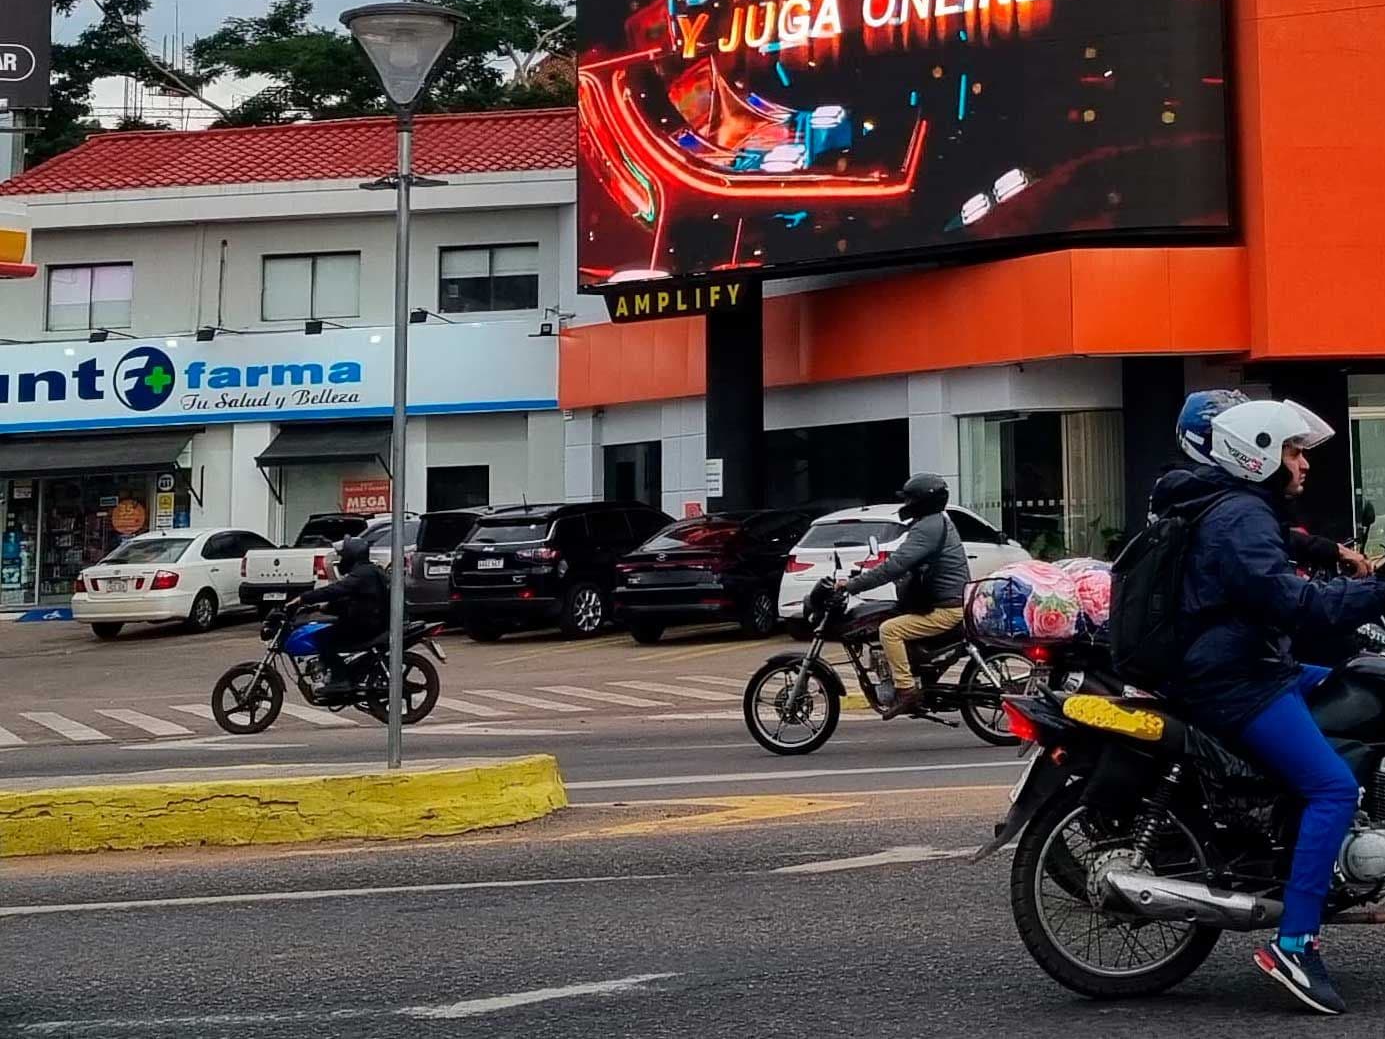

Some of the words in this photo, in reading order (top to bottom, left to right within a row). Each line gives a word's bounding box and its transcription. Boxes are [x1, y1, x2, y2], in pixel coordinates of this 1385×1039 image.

[677, 14, 709, 59] Y
[0, 52, 17, 71] R
[615, 283, 740, 317] AMPLIFY
[184, 361, 361, 390] farma
[180, 393, 208, 411] Tu
[215, 391, 270, 410] Salud
[275, 395, 286, 409] y
[292, 388, 361, 406] Belleza
[346, 496, 387, 508] MEGA
